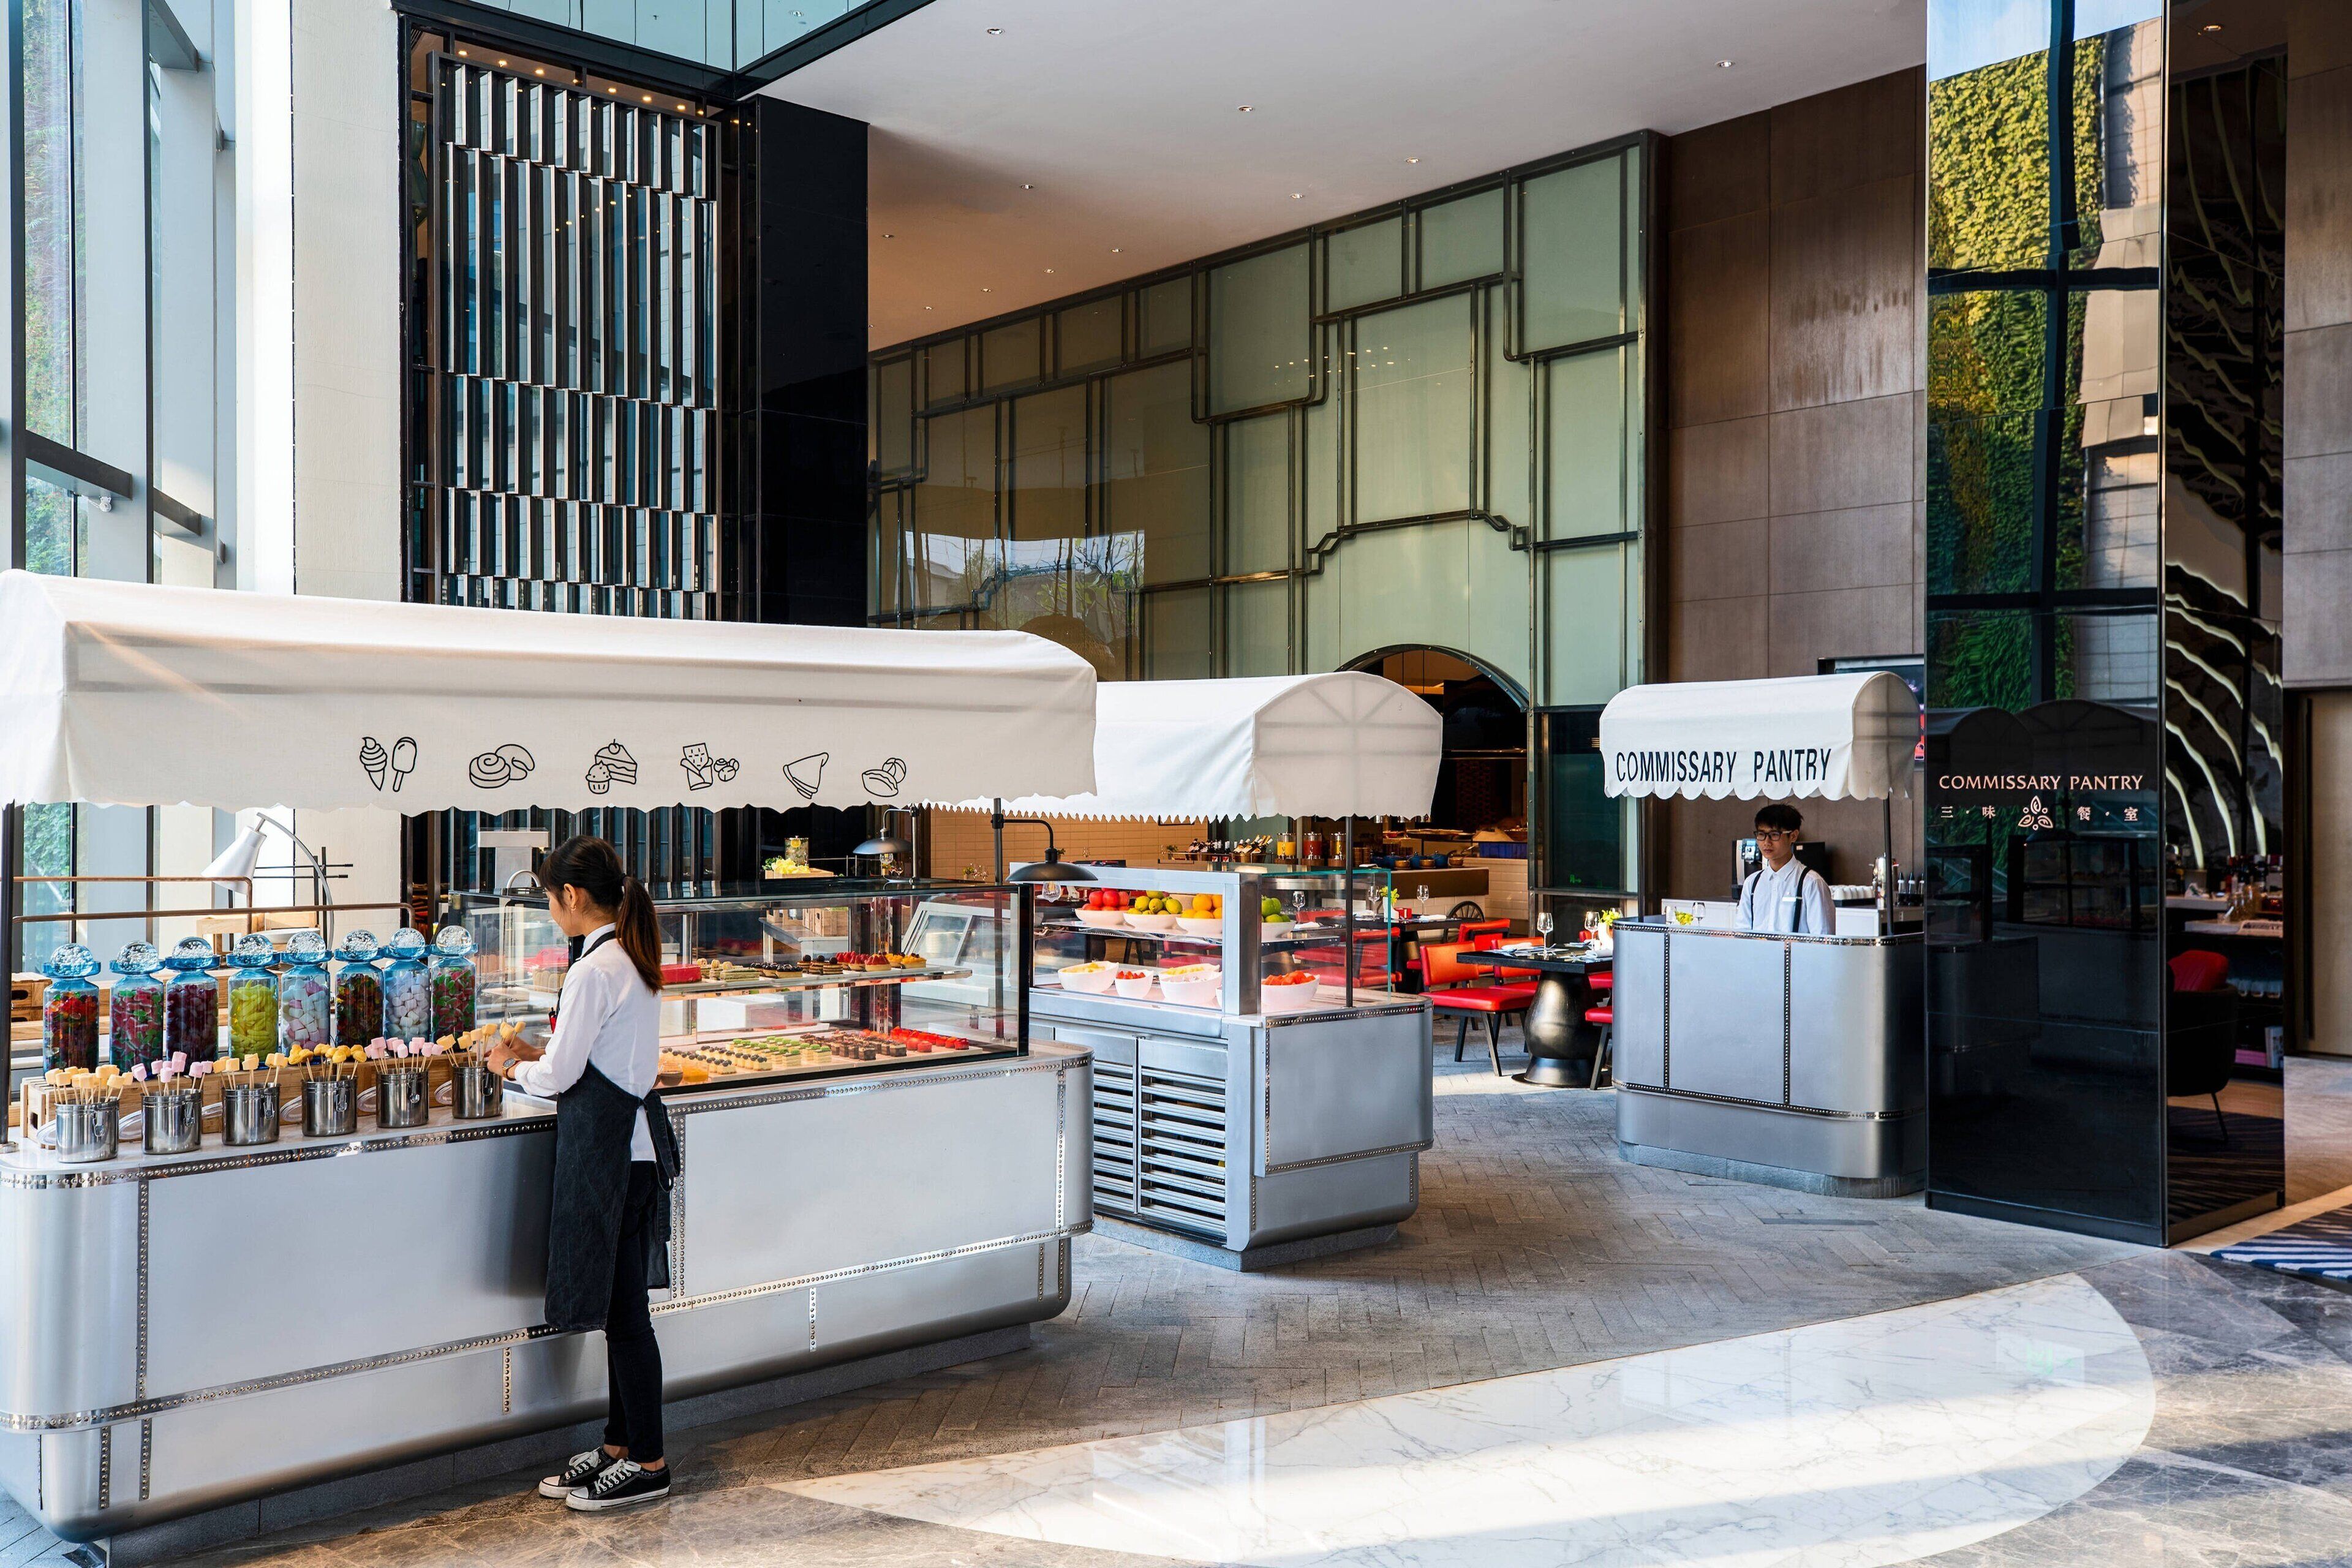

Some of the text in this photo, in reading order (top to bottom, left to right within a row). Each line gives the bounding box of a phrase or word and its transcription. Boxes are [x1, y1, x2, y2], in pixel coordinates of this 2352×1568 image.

[1616, 748, 1832, 783] COMMISSARY PANTRY
[1939, 775, 2144, 790] COMMISSARY PANTRY
